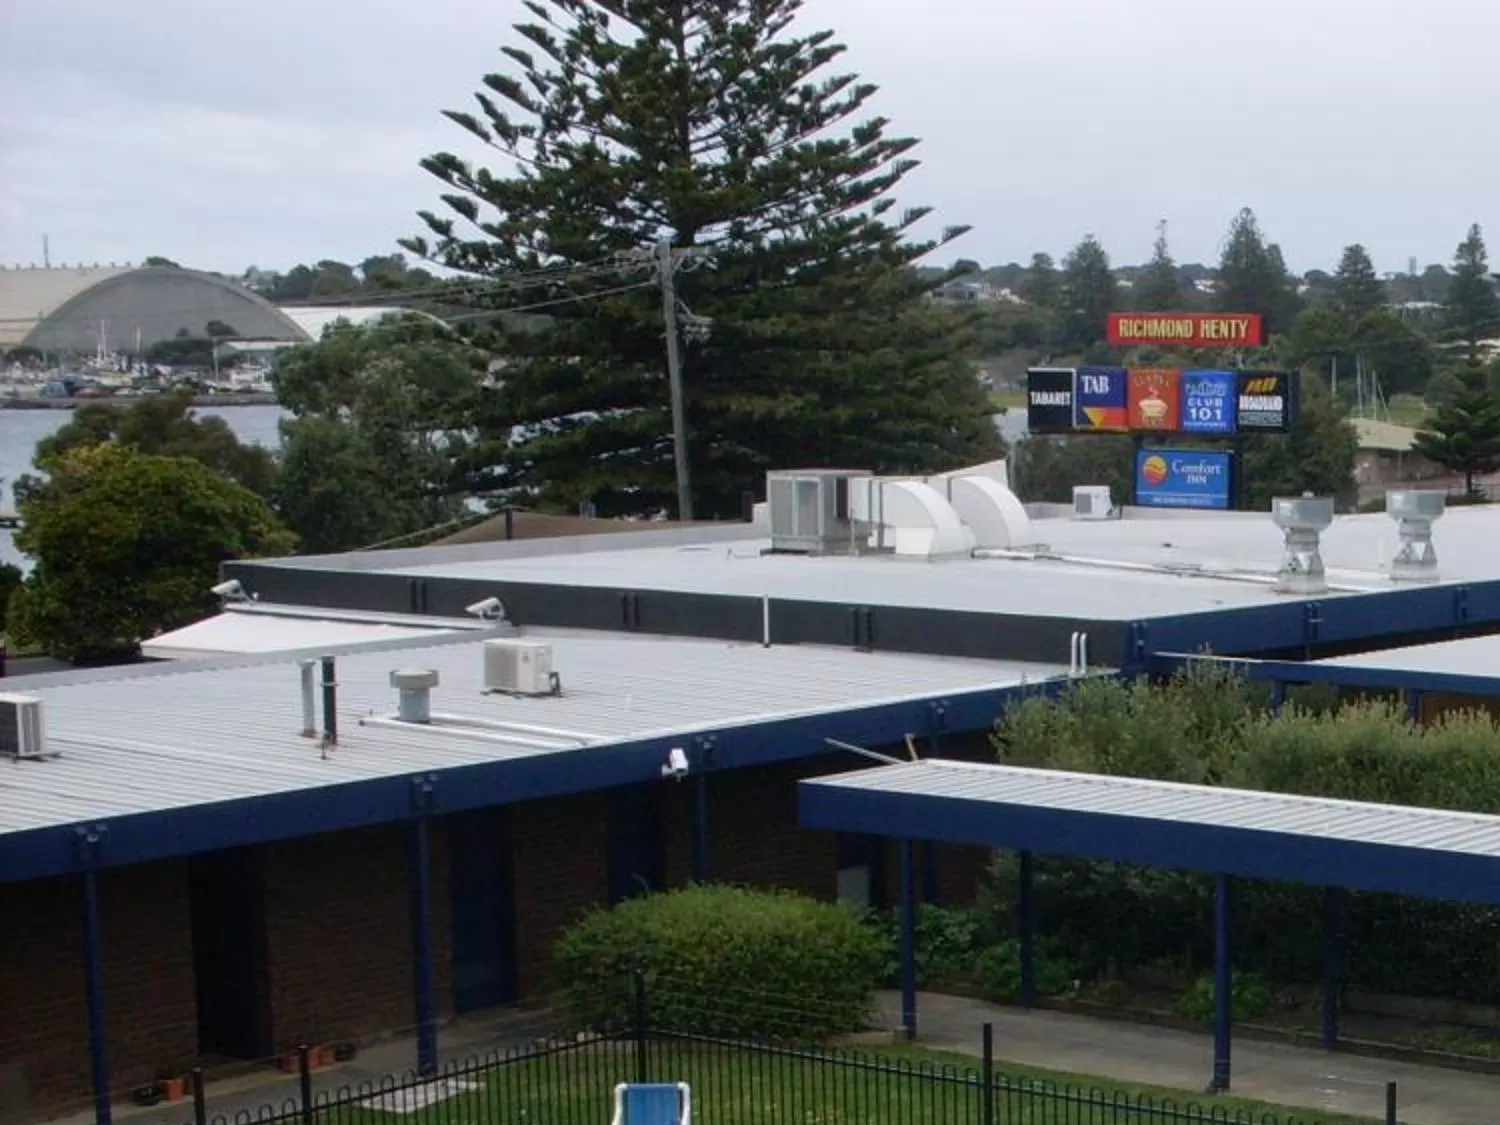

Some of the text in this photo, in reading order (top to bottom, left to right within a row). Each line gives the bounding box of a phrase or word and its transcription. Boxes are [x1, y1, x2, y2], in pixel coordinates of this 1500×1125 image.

[1119, 318, 1248, 339] RICHMOND HENTY
[1081, 375, 1109, 394] TAB
[1187, 397, 1223, 407] CLUB
[1190, 407, 1222, 421] 101
[1171, 459, 1222, 475] Comfort
